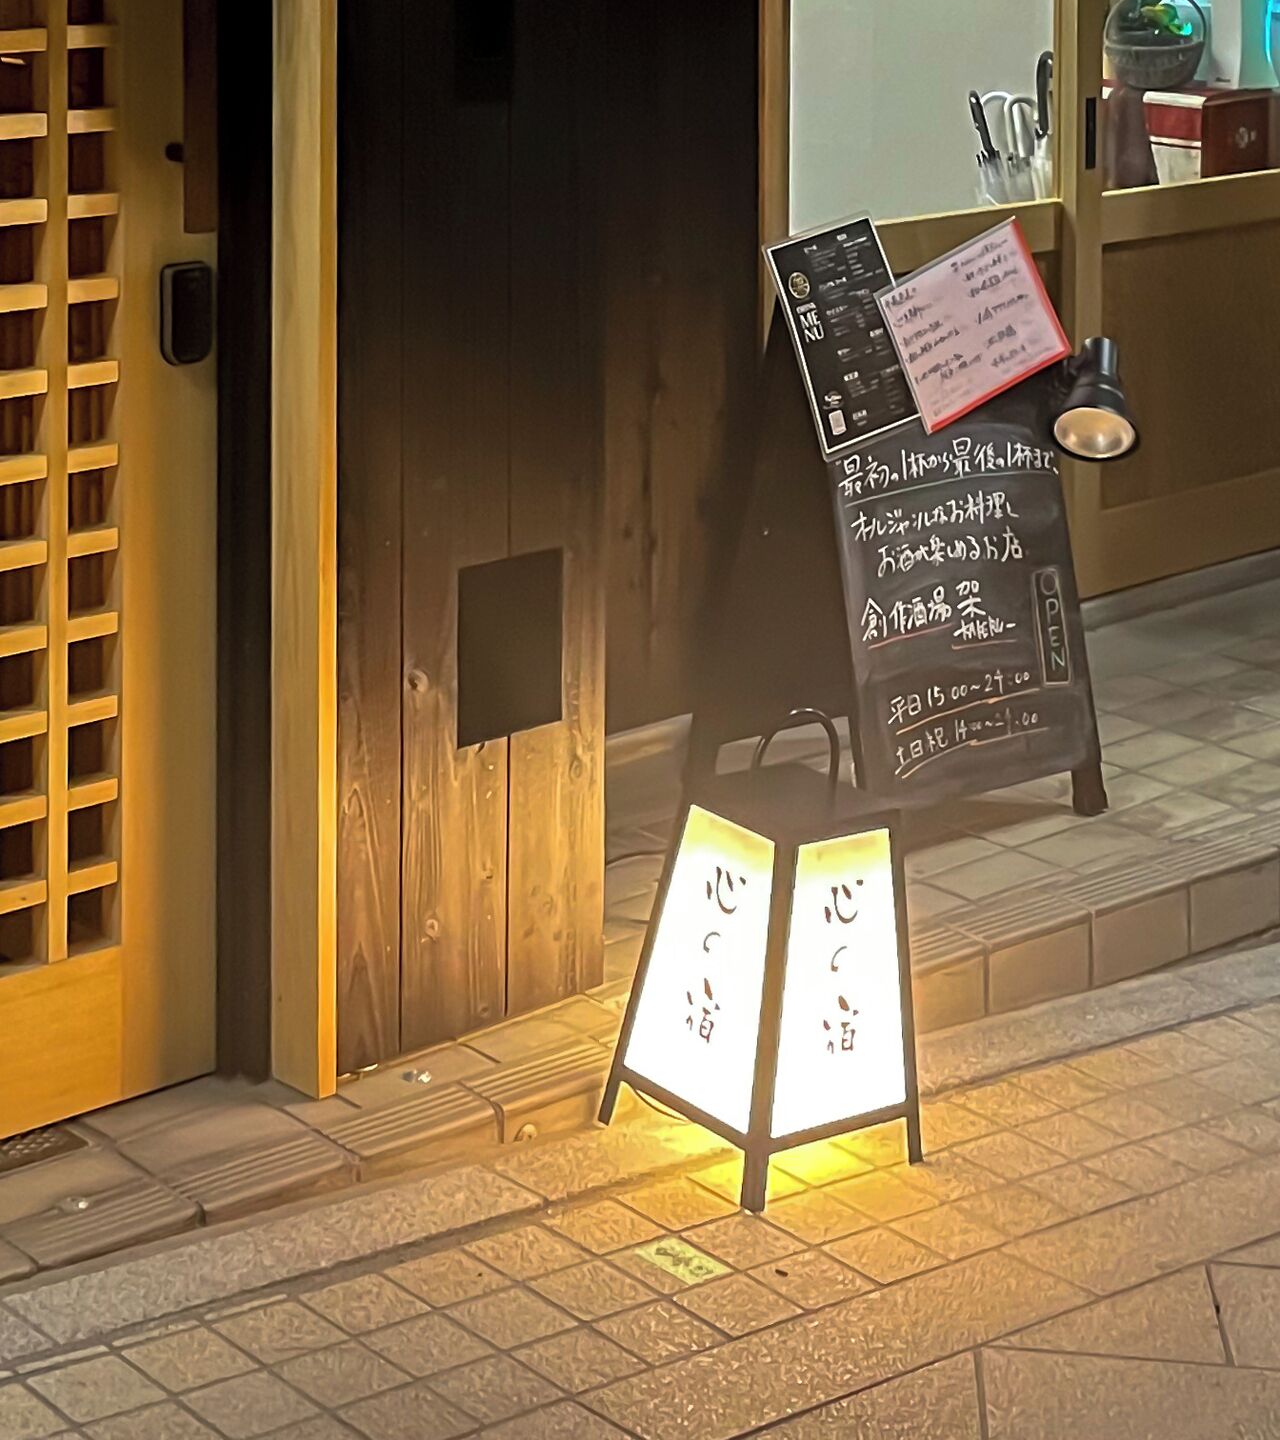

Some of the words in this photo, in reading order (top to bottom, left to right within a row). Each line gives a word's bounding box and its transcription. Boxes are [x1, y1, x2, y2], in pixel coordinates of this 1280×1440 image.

[861, 586, 952, 642] 創作酒場
[1040, 572, 1065, 671] OPEN
[888, 694, 921, 724] 平日
